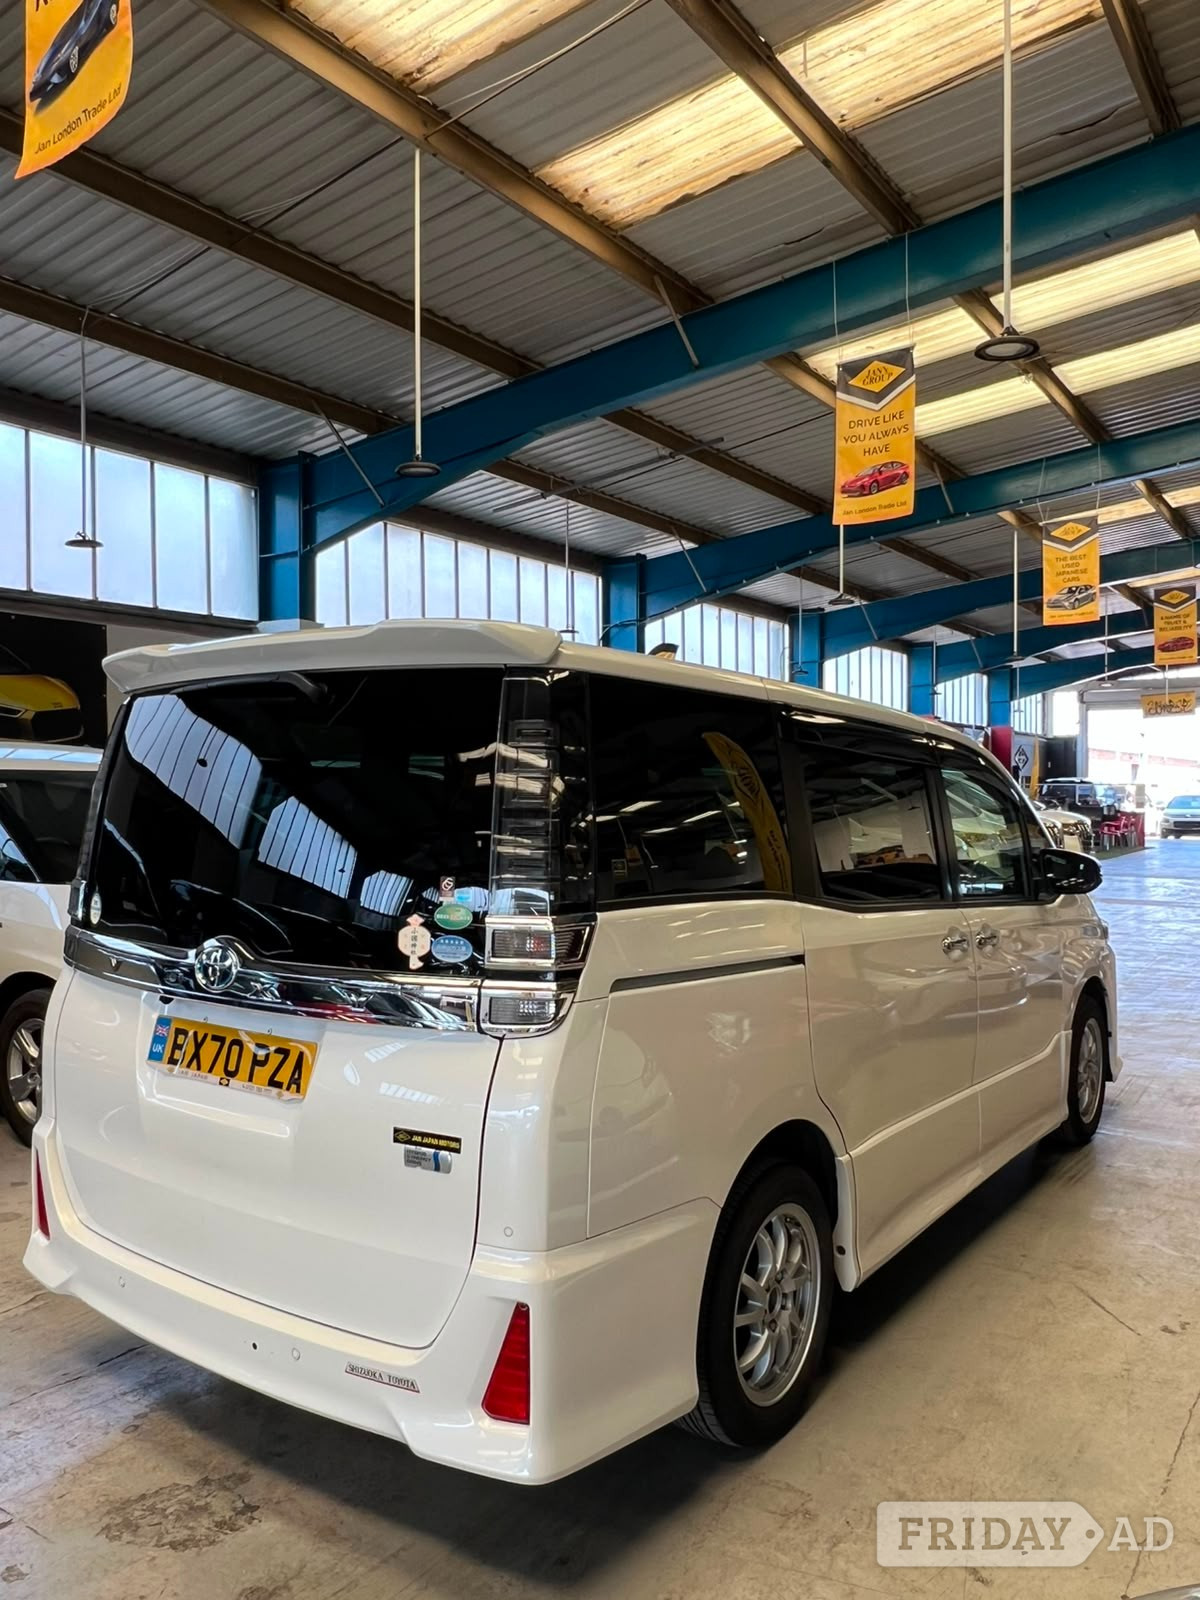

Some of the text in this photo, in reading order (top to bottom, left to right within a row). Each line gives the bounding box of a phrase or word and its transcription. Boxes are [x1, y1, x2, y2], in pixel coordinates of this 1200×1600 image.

[35, 83, 122, 154] Jan London Trade Ltd
[862, 372, 893, 386] GROUP
[848, 410, 905, 430] DRIVE LIKE
[843, 424, 910, 444] YOU ALWAYS
[863, 443, 890, 457] HAVE
[843, 508, 854, 516] Jan
[855, 506, 877, 515] London
[896, 500, 907, 508] Ltd
[1055, 568, 1088, 577] JAPANESE
[152, 1042, 163, 1053] UK
[167, 1027, 306, 1094] BX70 PZA
[423, 1137, 439, 1145] JAPAN
[348, 1364, 416, 1390] SHIZUOKA TOYOTA
